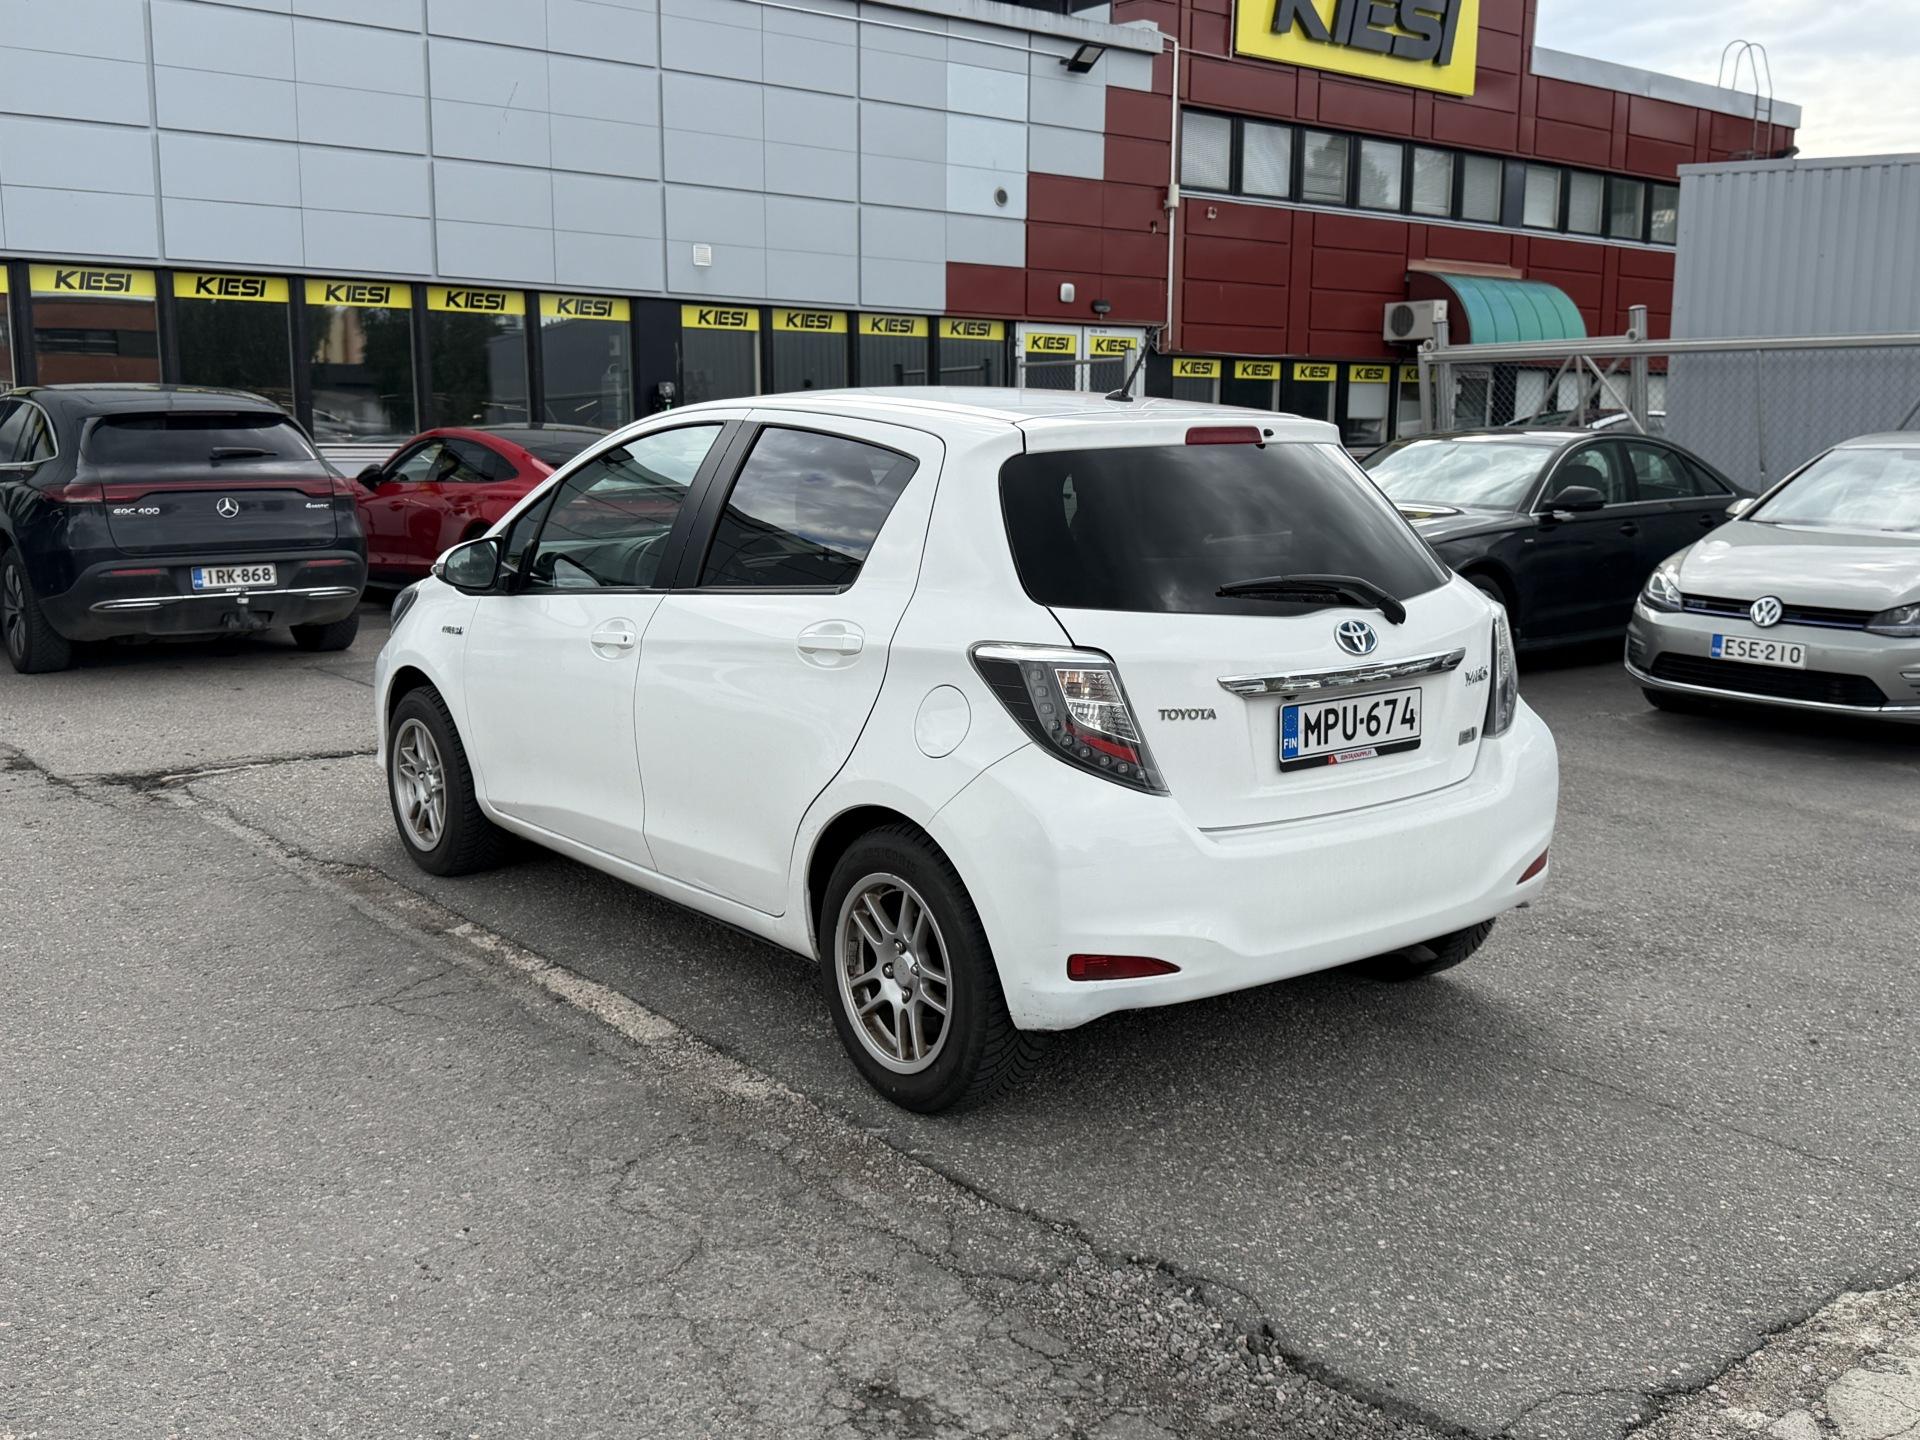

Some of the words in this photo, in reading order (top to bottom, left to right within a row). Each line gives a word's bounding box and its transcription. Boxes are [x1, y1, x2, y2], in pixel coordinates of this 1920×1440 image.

[1271, 0, 1462, 66] KIESI
[55, 270, 132, 292] KIESI
[195, 276, 266, 297] KIESI
[325, 284, 390, 304] KIESI
[445, 290, 507, 311] KIESI
[557, 298, 613, 317] KIESI
[698, 309, 748, 327] KIESI
[786, 312, 833, 330] KIESI
[871, 317, 914, 334] KIESI
[950, 319, 991, 337] KIESI
[1031, 336, 1070, 350] KIESI
[1095, 339, 1132, 352] KIESI
[1180, 360, 1213, 375] KIESI
[1241, 363, 1273, 377] KIESI
[1300, 365, 1330, 378] KIESI
[1355, 368, 1384, 380] KIESI
[208, 567, 272, 585] IRK-868
[1724, 639, 1801, 663] ESE-210
[1158, 708, 1217, 721] TOYOTA
[1303, 696, 1416, 749] MPU-674
[1283, 736, 1298, 749] FIN
